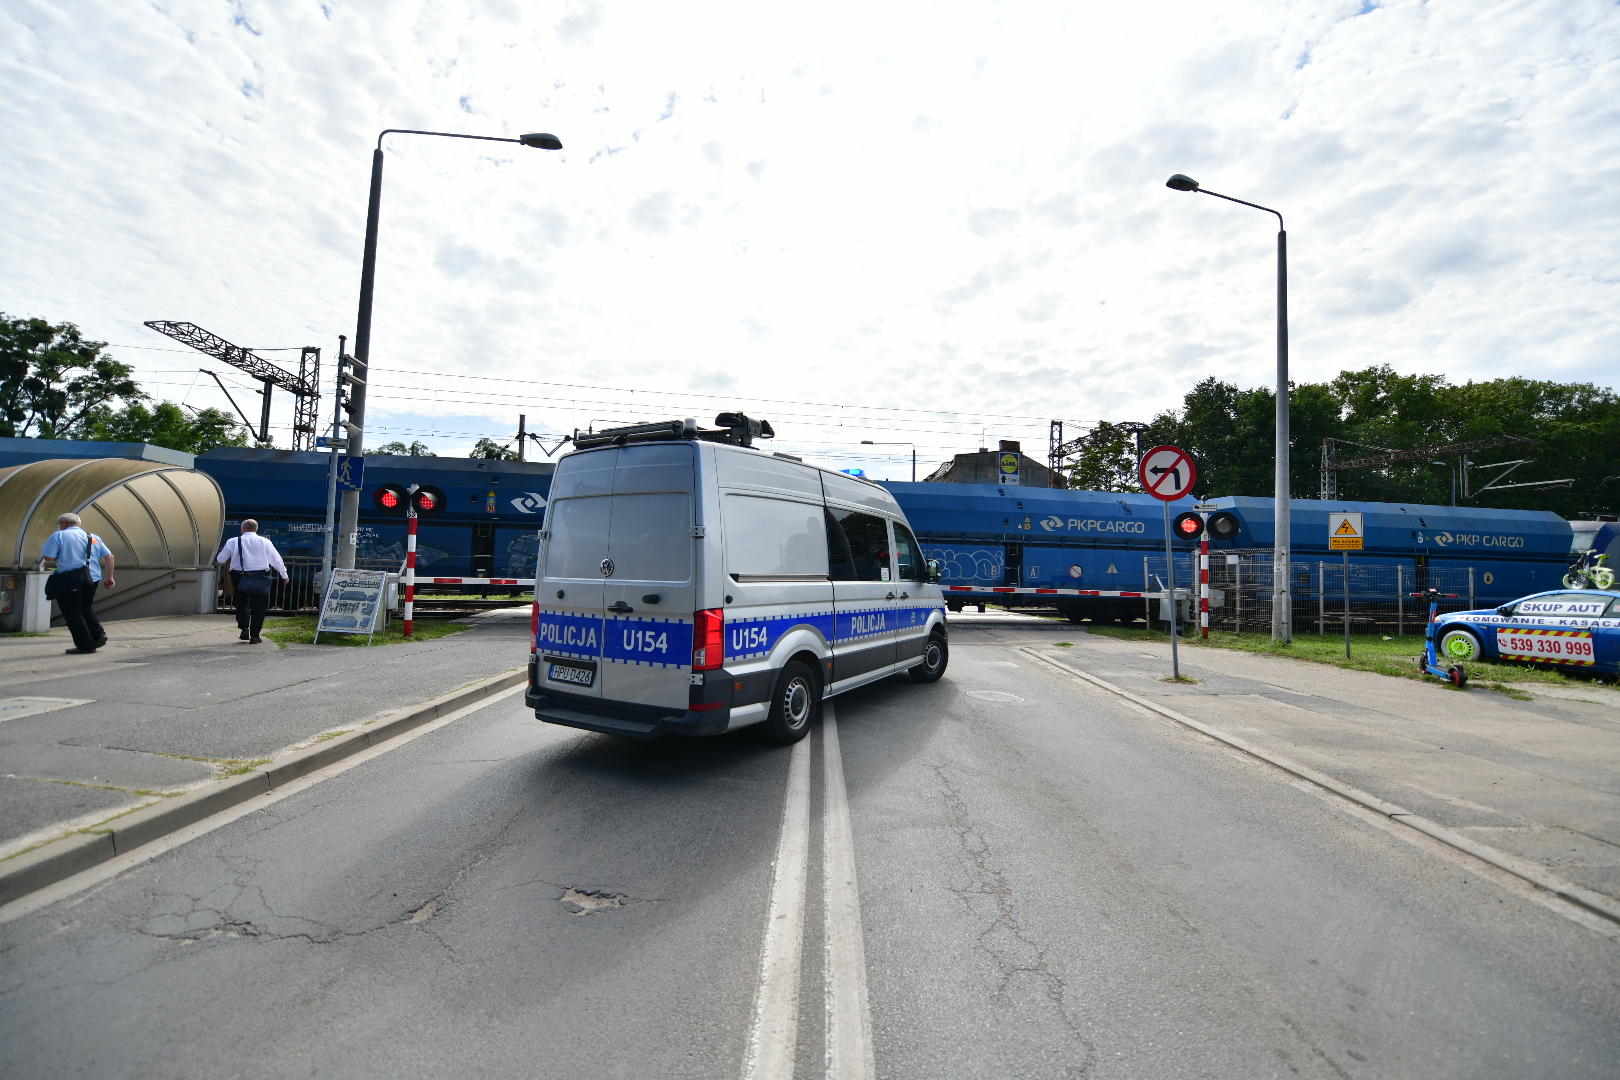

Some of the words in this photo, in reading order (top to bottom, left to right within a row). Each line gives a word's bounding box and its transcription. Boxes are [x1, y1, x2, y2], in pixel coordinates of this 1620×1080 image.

[407, 510, 416, 518] S3
[1456, 534, 1480, 546] PKP
[1483, 535, 1524, 548] CARGO
[1522, 603, 1563, 612] SKUP
[1567, 604, 1602, 613] AUT
[851, 613, 886, 635] POLICJA
[539, 622, 597, 649] POLICJA
[623, 629, 668, 654] U154
[732, 626, 768, 650] U154
[1510, 637, 1533, 652] 539
[1536, 639, 1562, 654] 330
[1565, 641, 1592, 656] 999
